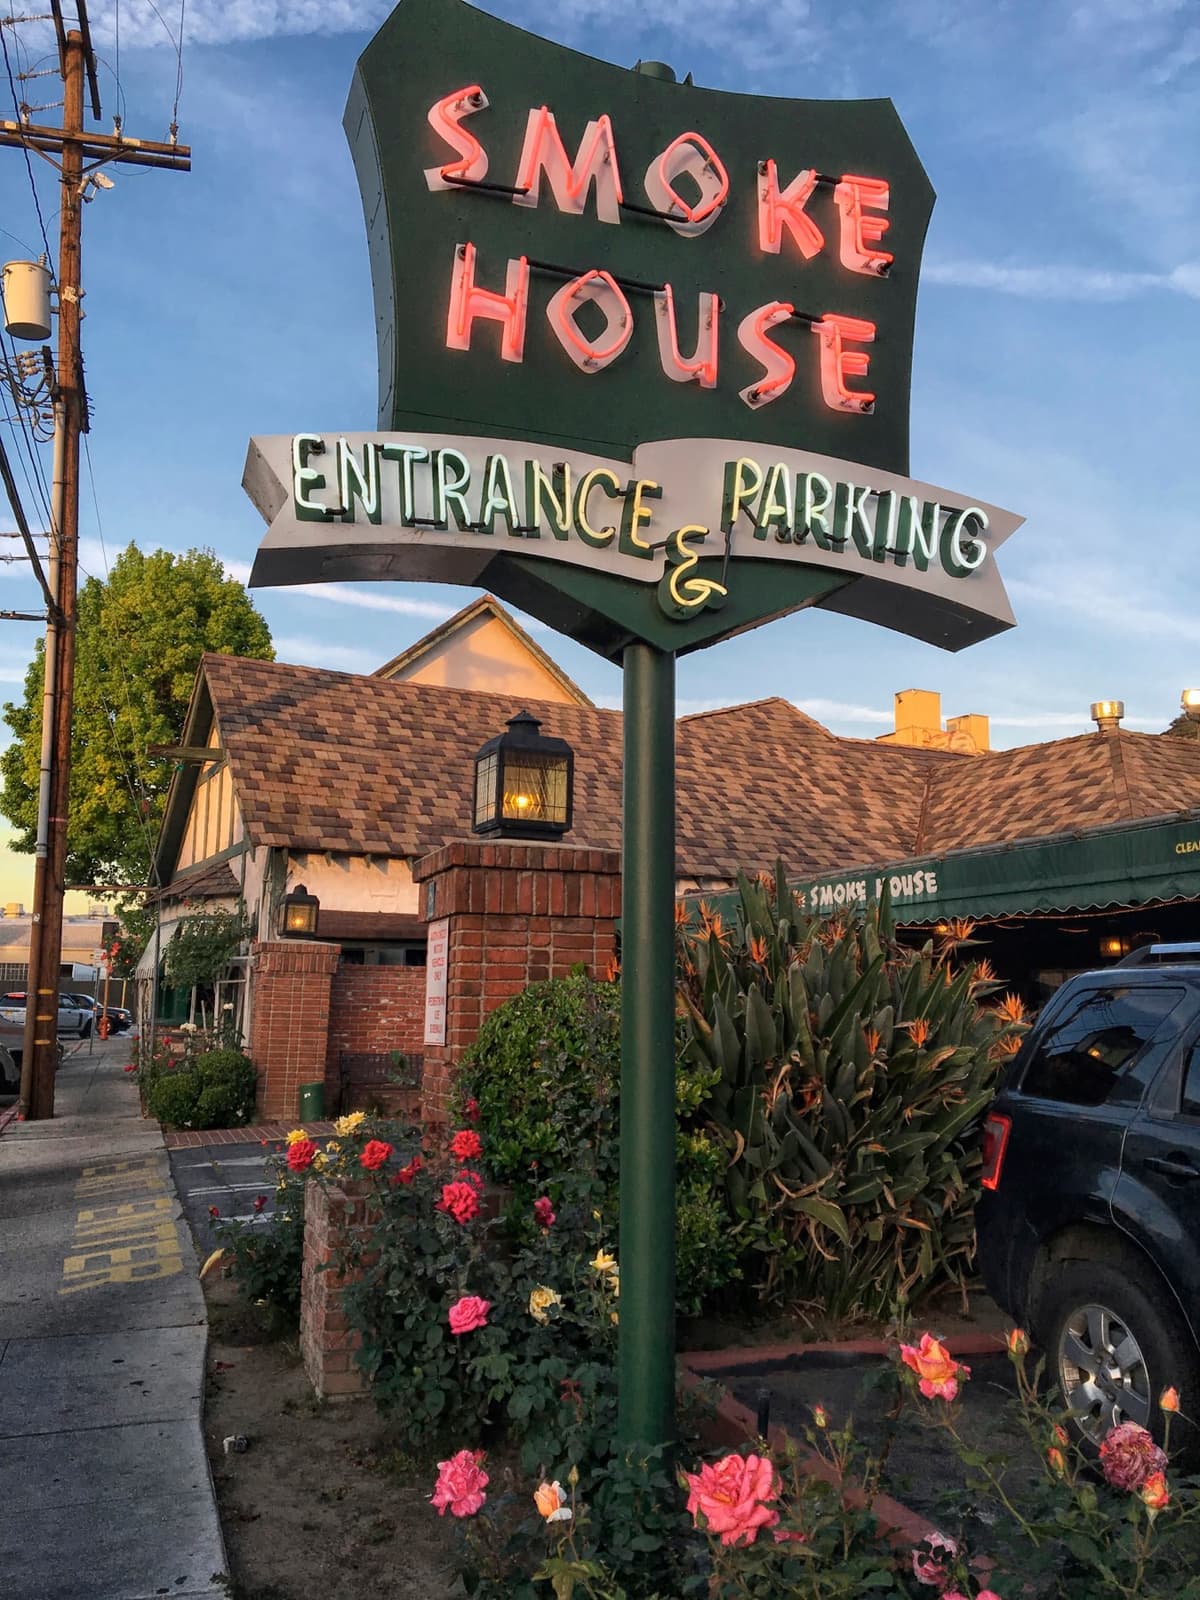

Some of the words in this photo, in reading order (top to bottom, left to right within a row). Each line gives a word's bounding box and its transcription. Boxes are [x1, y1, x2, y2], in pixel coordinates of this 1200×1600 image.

[424, 85, 892, 278] SMOKE
[446, 241, 876, 414] HOUSE
[292, 433, 662, 560] ENTRANCE
[658, 525, 728, 620] &
[720, 457, 989, 578] PARKING
[810, 881, 866, 906] SMOKE
[1175, 840, 1200, 855] CLEA
[56, 1196, 184, 1295] ENTER
